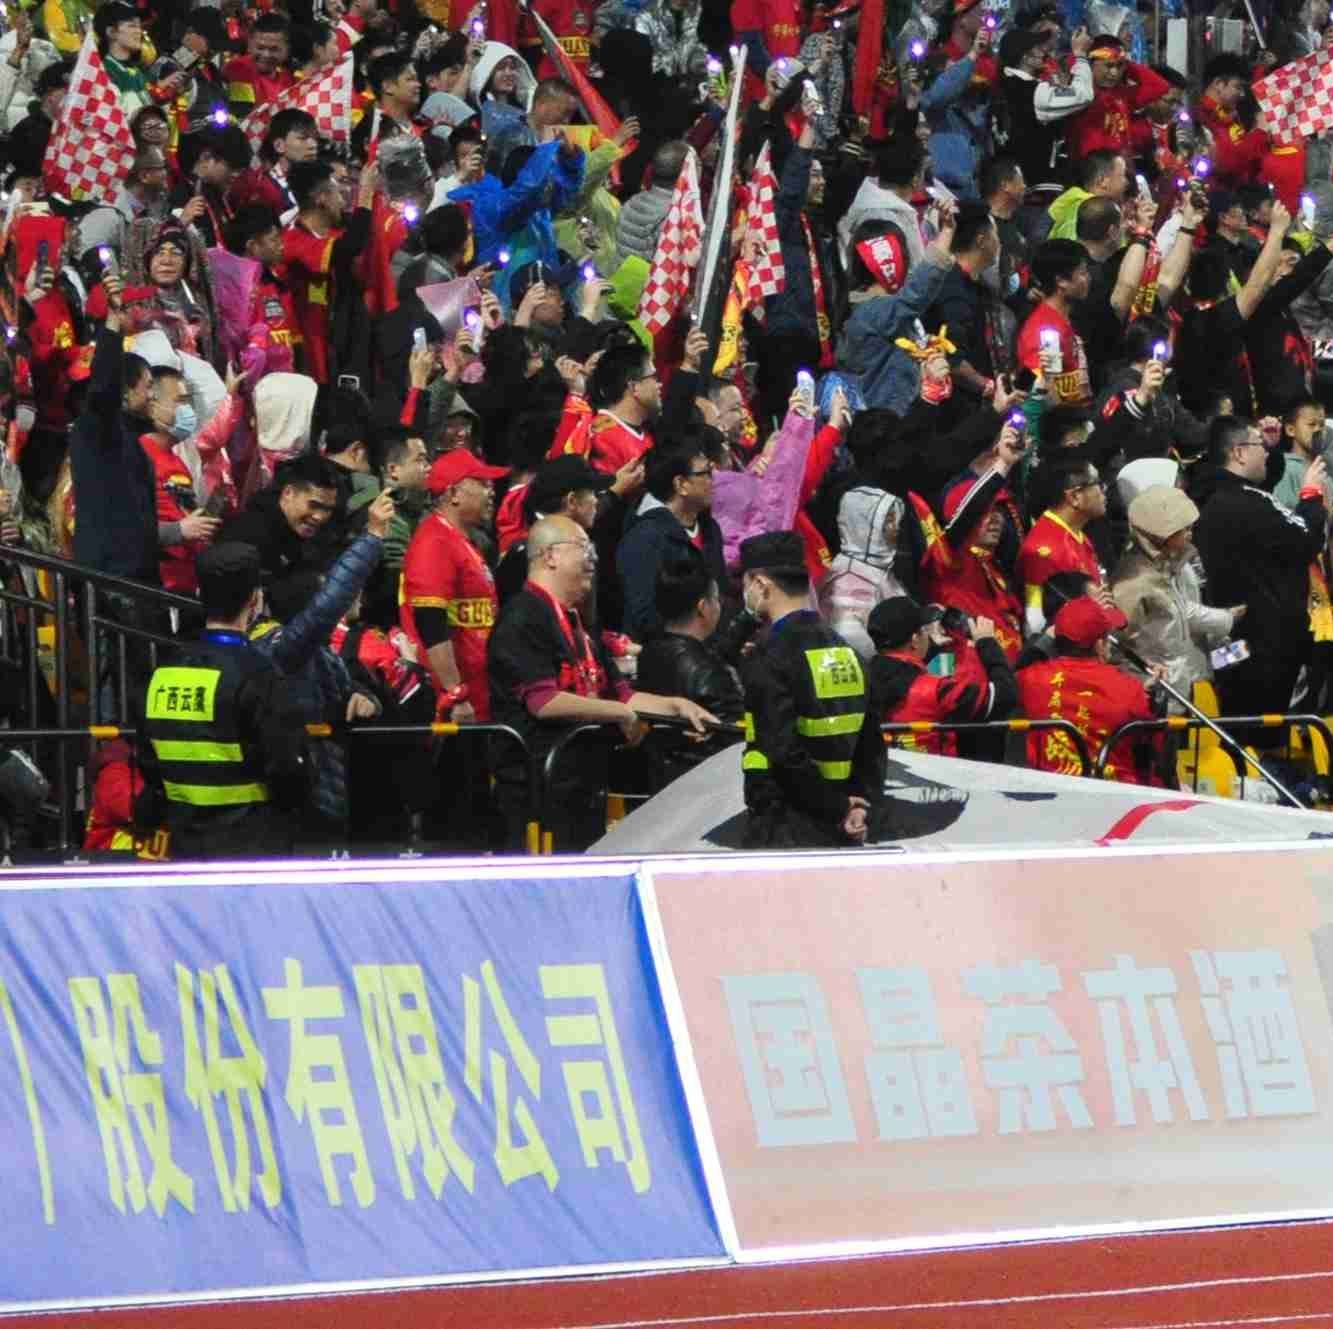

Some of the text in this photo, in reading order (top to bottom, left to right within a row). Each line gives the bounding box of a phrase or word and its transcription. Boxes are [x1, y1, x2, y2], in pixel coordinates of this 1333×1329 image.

[0, 957, 652, 1225] 股份有限公司
